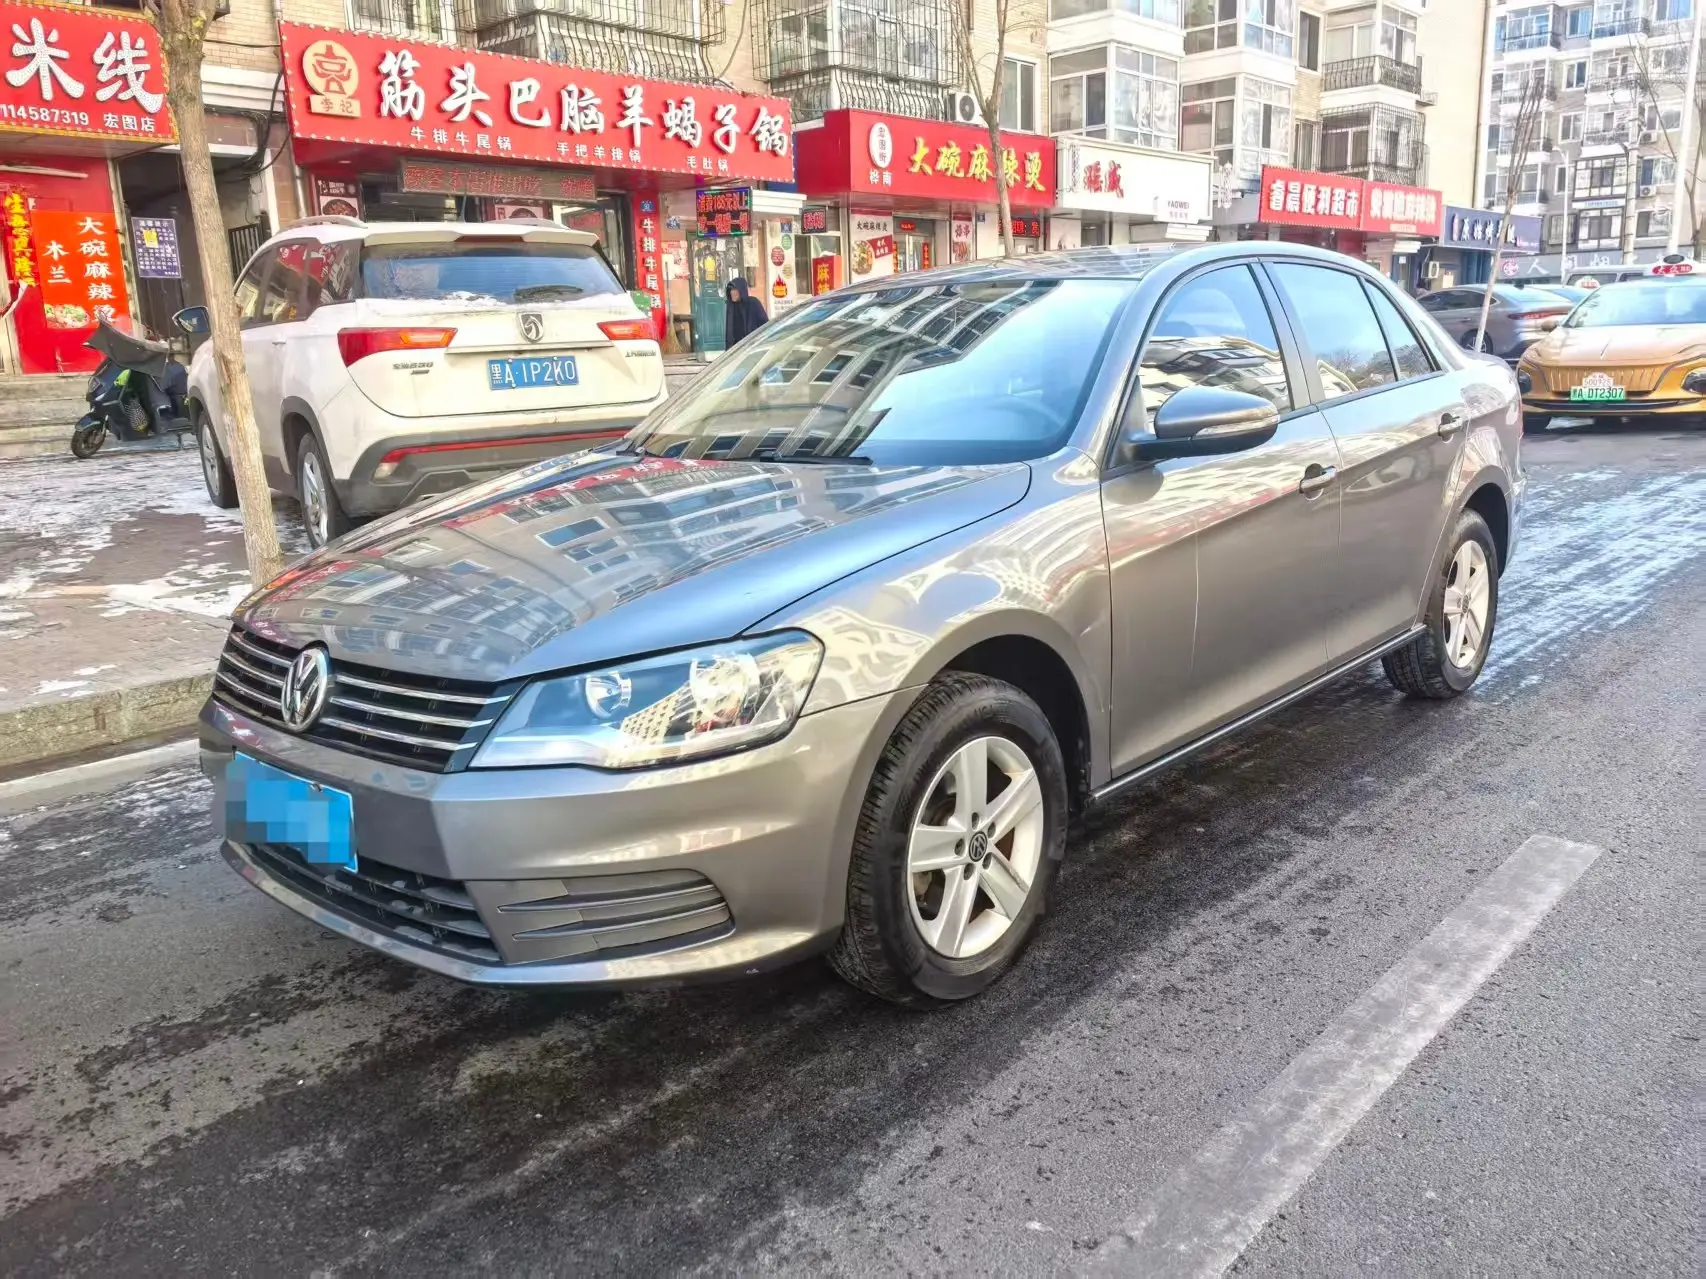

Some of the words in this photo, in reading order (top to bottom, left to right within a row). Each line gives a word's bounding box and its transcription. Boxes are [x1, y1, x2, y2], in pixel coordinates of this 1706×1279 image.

[5, 17, 164, 114] 米线
[377, 48, 789, 157] 筋头巴脑羊蝎子锅
[103, 113, 155, 132] 宏图店
[410, 126, 512, 151] 牛排牛尾锅
[556, 142, 642, 163] 手把羊排锅
[687, 155, 729, 172] 毛肚锅
[78, 216, 118, 323] 大碗麻辣烫
